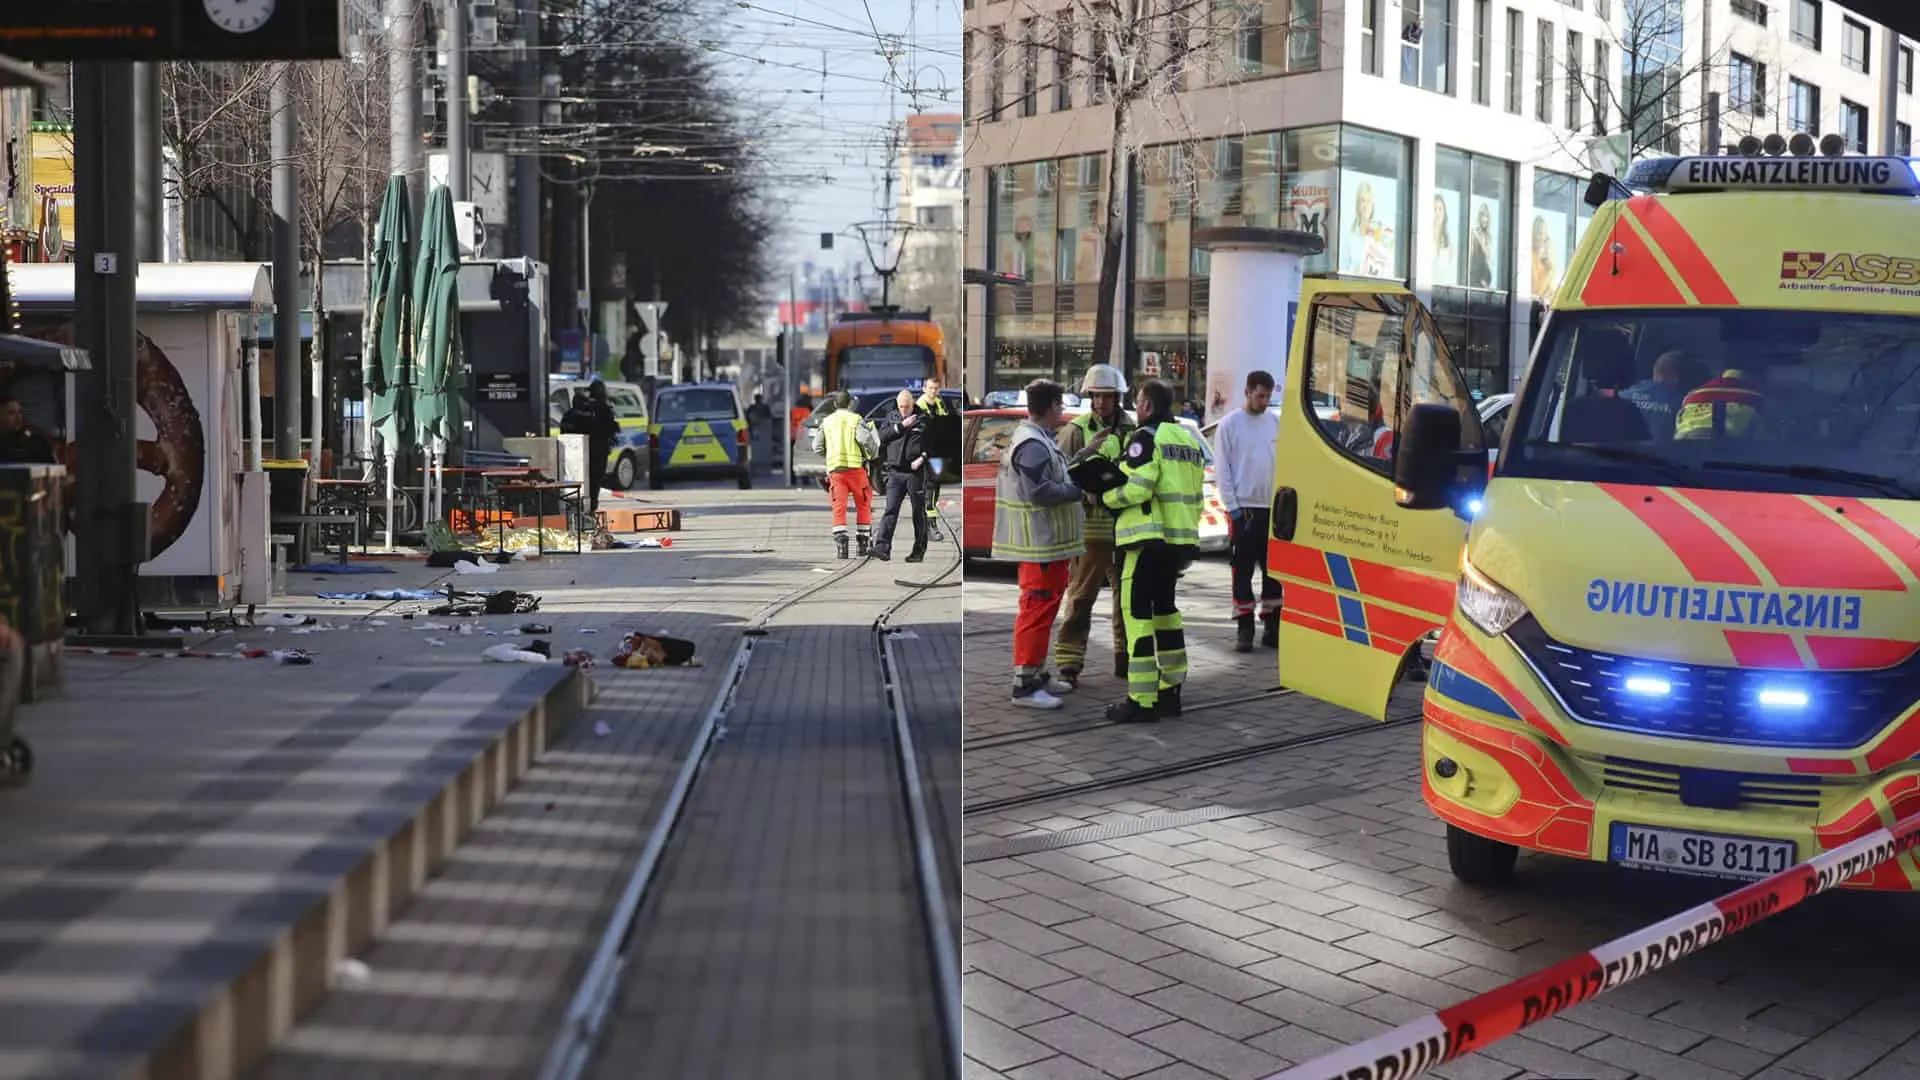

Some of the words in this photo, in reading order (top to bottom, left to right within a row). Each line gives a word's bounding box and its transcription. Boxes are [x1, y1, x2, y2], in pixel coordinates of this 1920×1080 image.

[1688, 160, 1890, 185] EINSATZLEITUNG
[1301, 213, 1320, 233] M
[101, 257, 109, 272] 3
[1812, 252, 1920, 285] ASB
[1629, 831, 1659, 862] MA
[1681, 837, 1714, 866] SB
[1722, 842, 1788, 874] 8111
